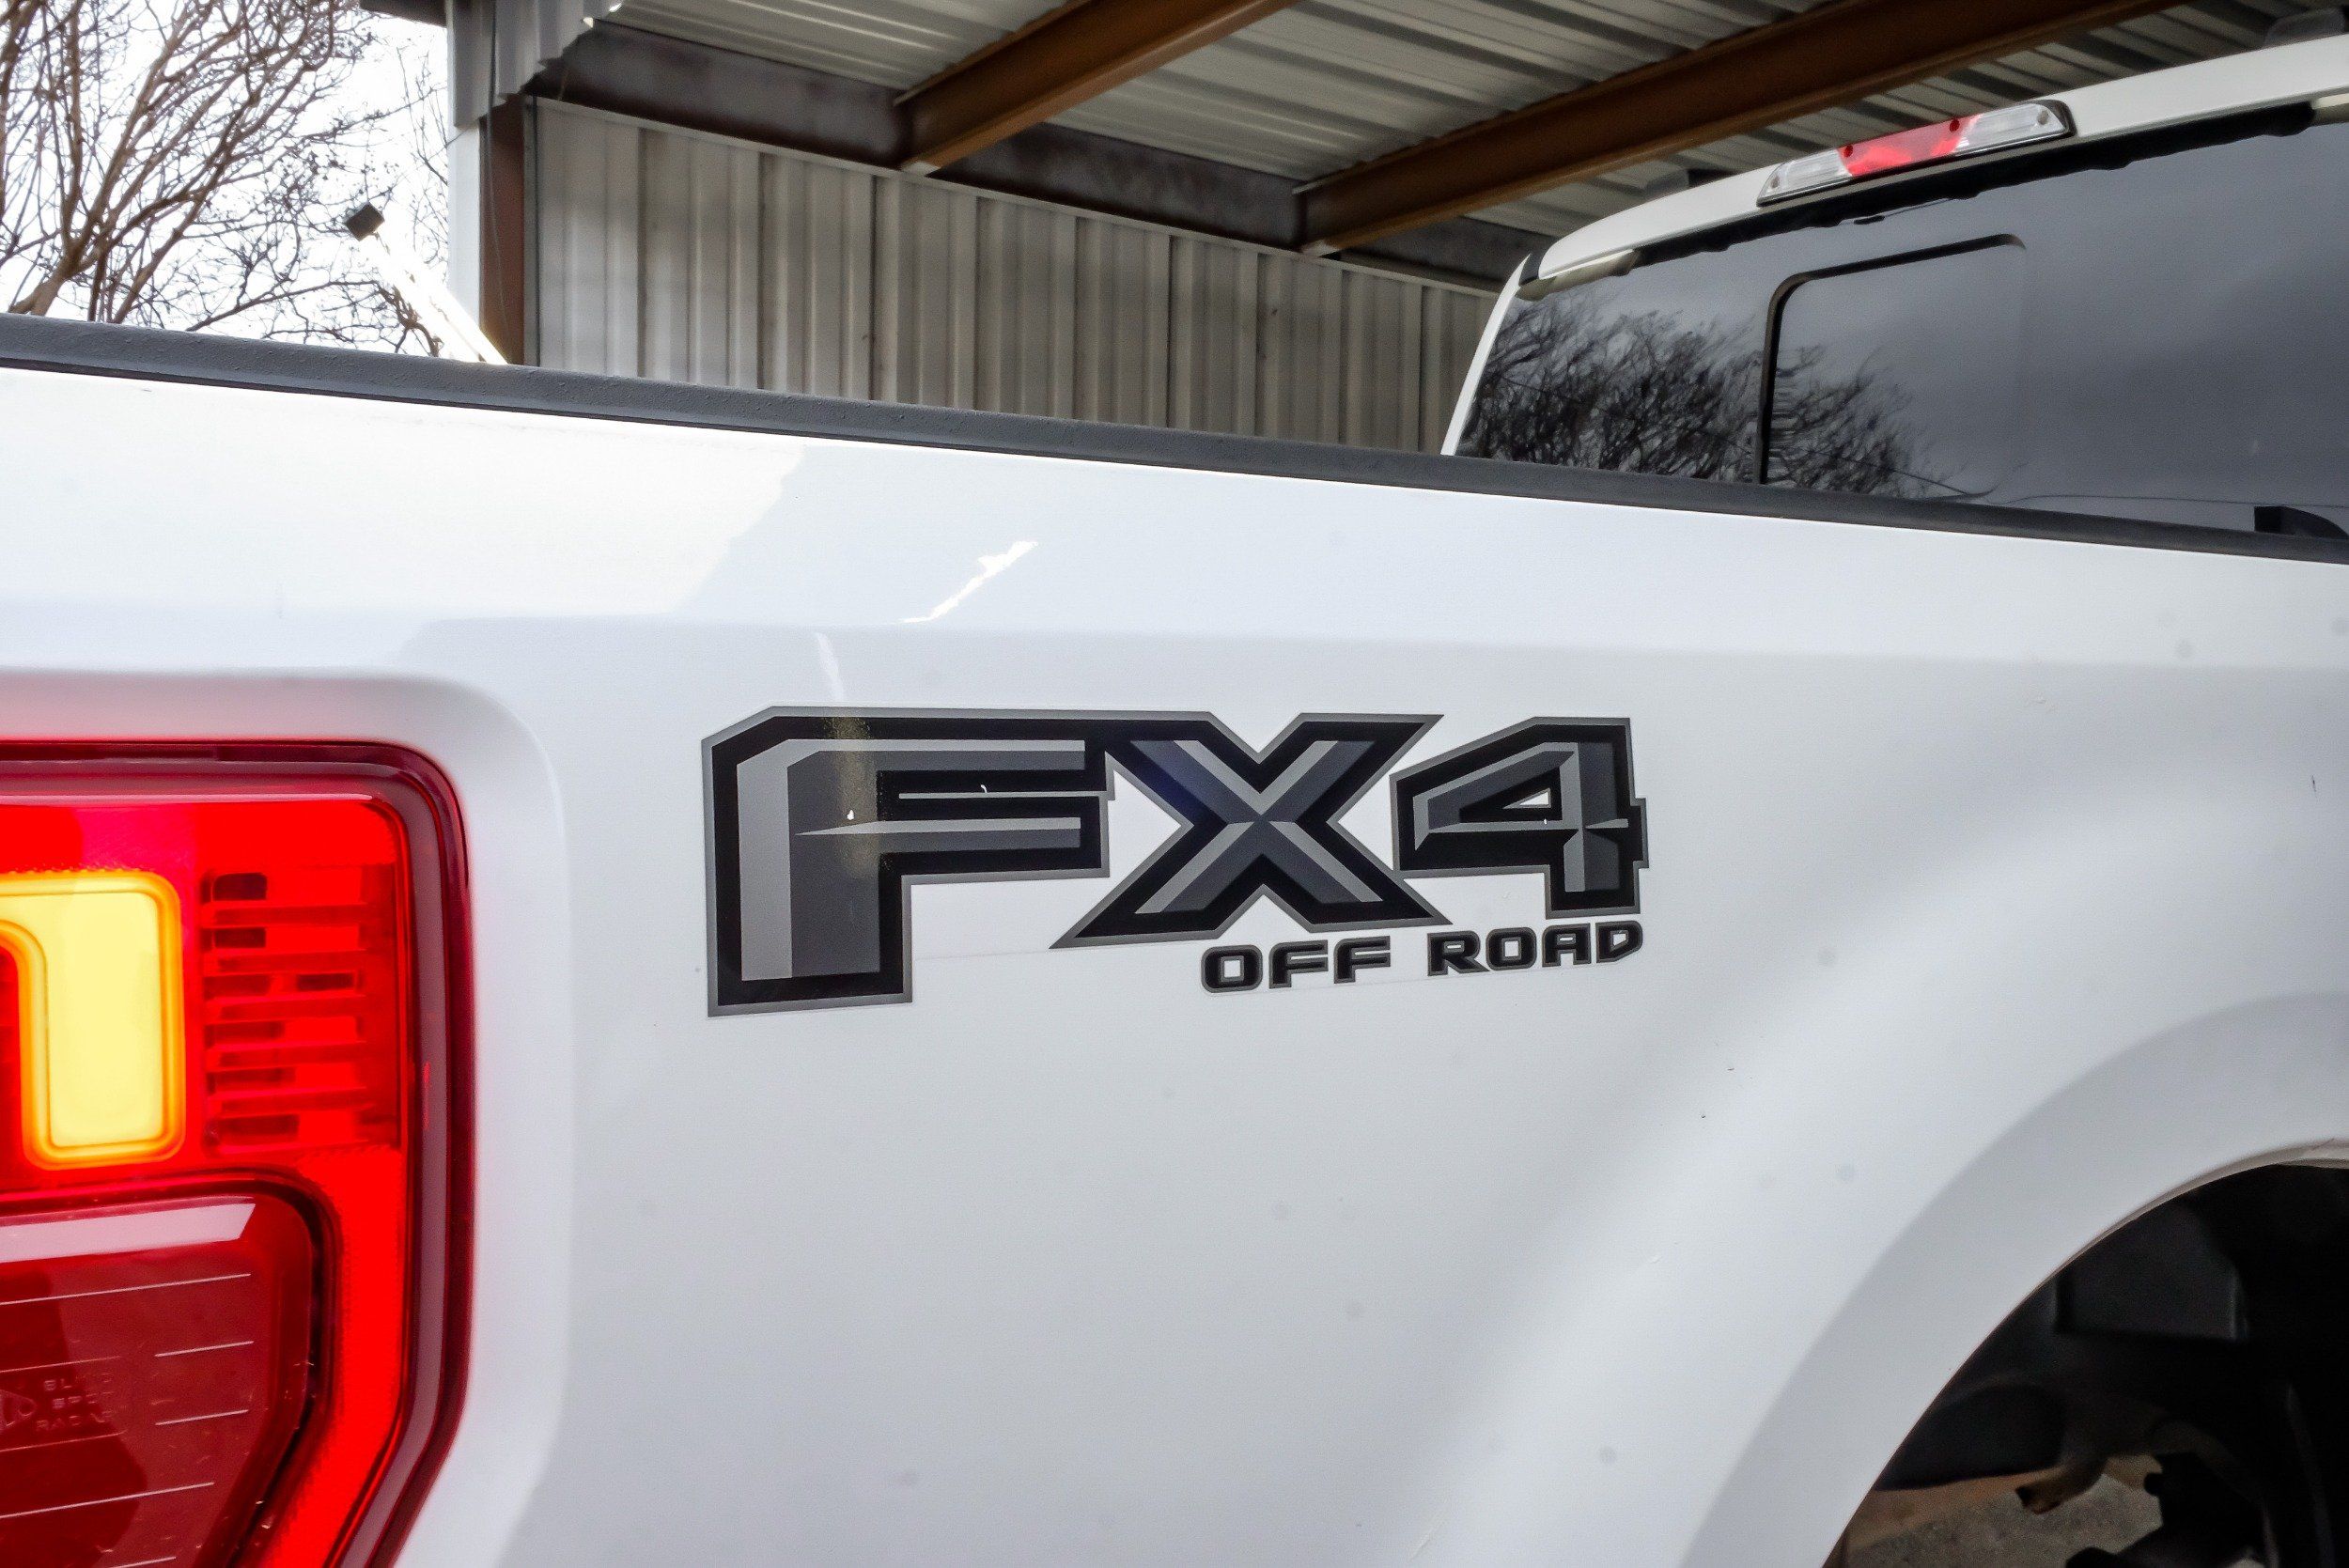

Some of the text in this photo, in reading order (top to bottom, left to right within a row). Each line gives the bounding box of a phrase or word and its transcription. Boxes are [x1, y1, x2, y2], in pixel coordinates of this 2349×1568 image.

[701, 706, 1648, 1017] FX4
[1201, 920, 1644, 994] OFF ROAD
